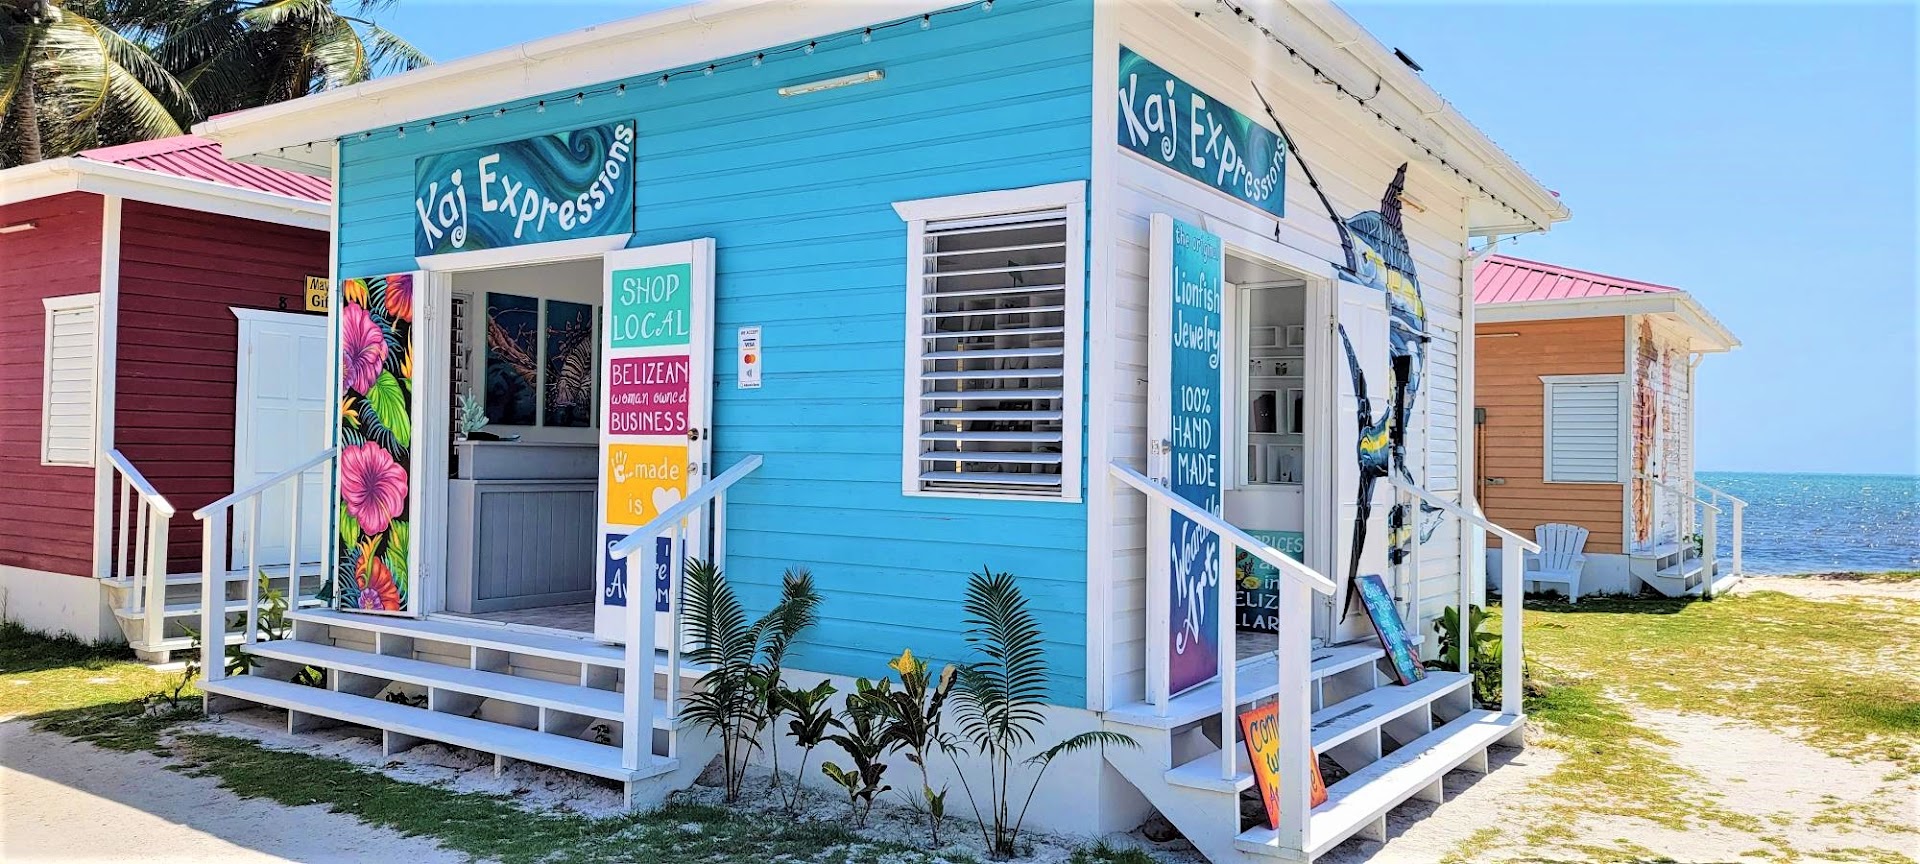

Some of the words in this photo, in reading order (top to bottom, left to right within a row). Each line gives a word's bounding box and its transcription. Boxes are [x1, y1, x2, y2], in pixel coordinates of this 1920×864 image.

[1118, 73, 1177, 162] Kaj
[1190, 92, 1286, 202] Expressions
[416, 168, 468, 249] Kaj
[478, 123, 634, 239] Expressions
[1175, 223, 1190, 249] the
[279, 296, 287, 309] 8
[620, 273, 680, 306] SHOP
[1174, 265, 1220, 314] Lionfish
[613, 309, 689, 341] LOCAL
[1174, 309, 1220, 369] Jewelry
[612, 361, 688, 386] BELIZEAN
[611, 391, 649, 406] woman
[653, 387, 687, 404] owned
[1180, 384, 1211, 414] 100%
[611, 411, 686, 432] BUSINESS
[1172, 415, 1211, 450] HAND
[1178, 452, 1217, 487] MADE
[629, 493, 643, 515] is
[1175, 541, 1219, 655] Art
[1250, 714, 1279, 753] Com
